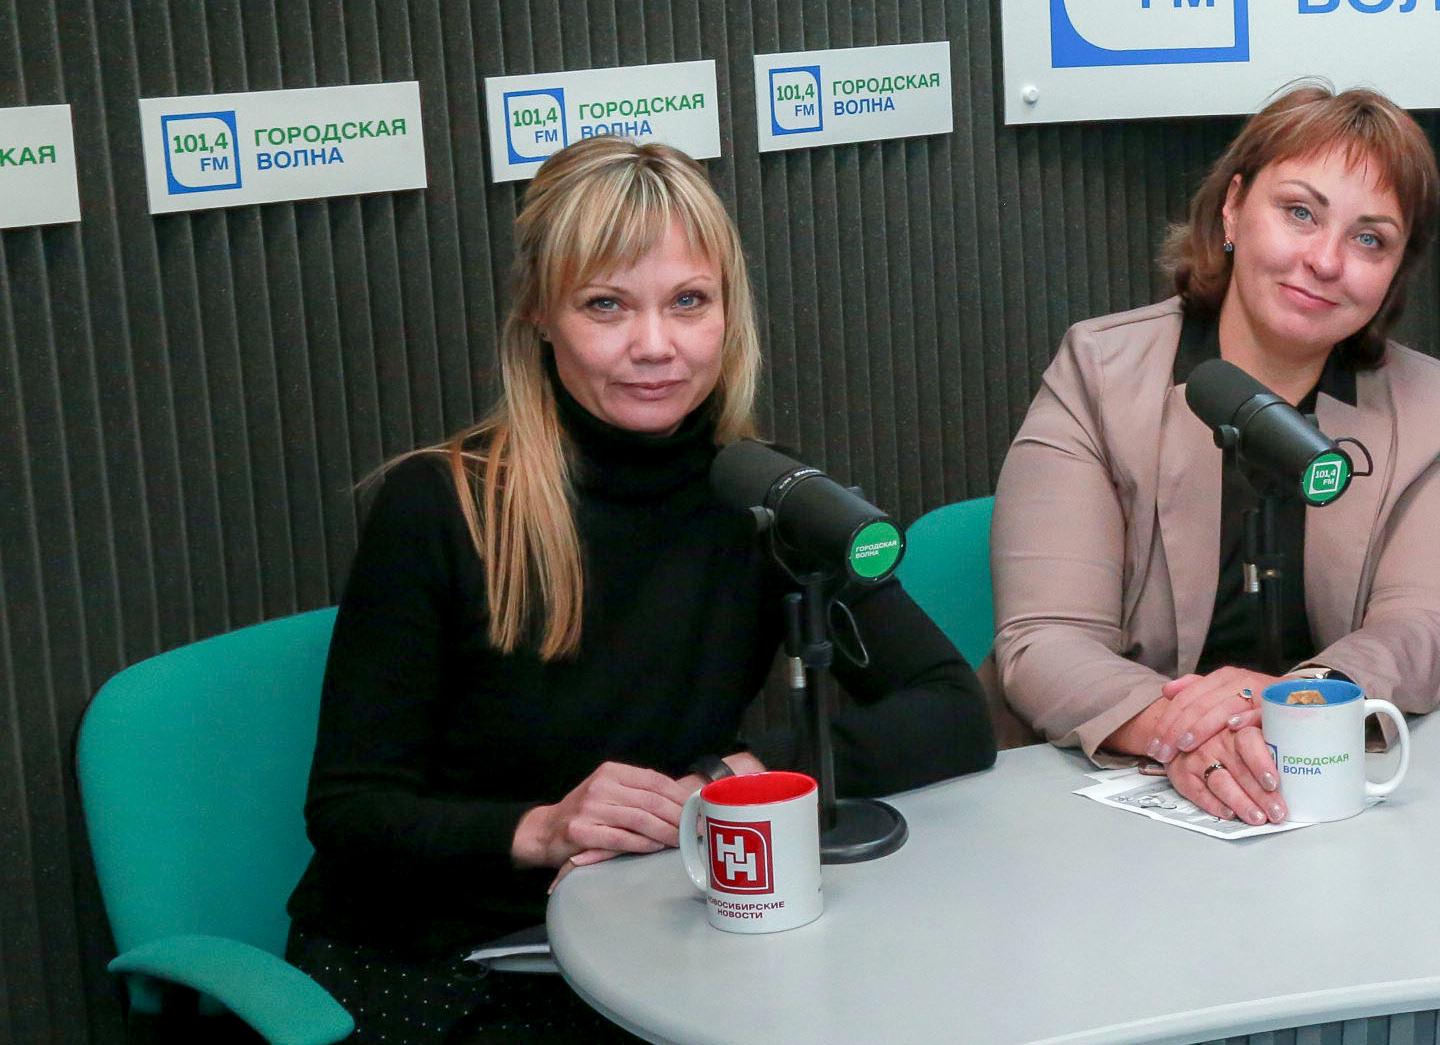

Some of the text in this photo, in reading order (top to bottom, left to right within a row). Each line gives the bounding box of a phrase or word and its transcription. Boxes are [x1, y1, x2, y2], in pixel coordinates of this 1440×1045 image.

[777, 84, 815, 102] 101,4
[833, 73, 940, 96] ГОРОДСКАЯ
[578, 93, 705, 121] ГОРОДСКАЯ
[795, 104, 815, 117] FM
[834, 96, 895, 116] ВОЛНА
[513, 106, 558, 128] 101,4
[254, 118, 406, 147] ГОРОДСКАЯ
[535, 129, 558, 144] FM
[581, 120, 653, 139] ВОЛНА
[173, 132, 228, 154] 101,4
[200, 156, 229, 172] FM
[256, 147, 344, 171] ВОЛНА
[1283, 753, 1350, 767] ГОРОДСКАЯ
[1283, 765, 1322, 775] ВОЛНА
[718, 908, 763, 919] НОВОСТИ
